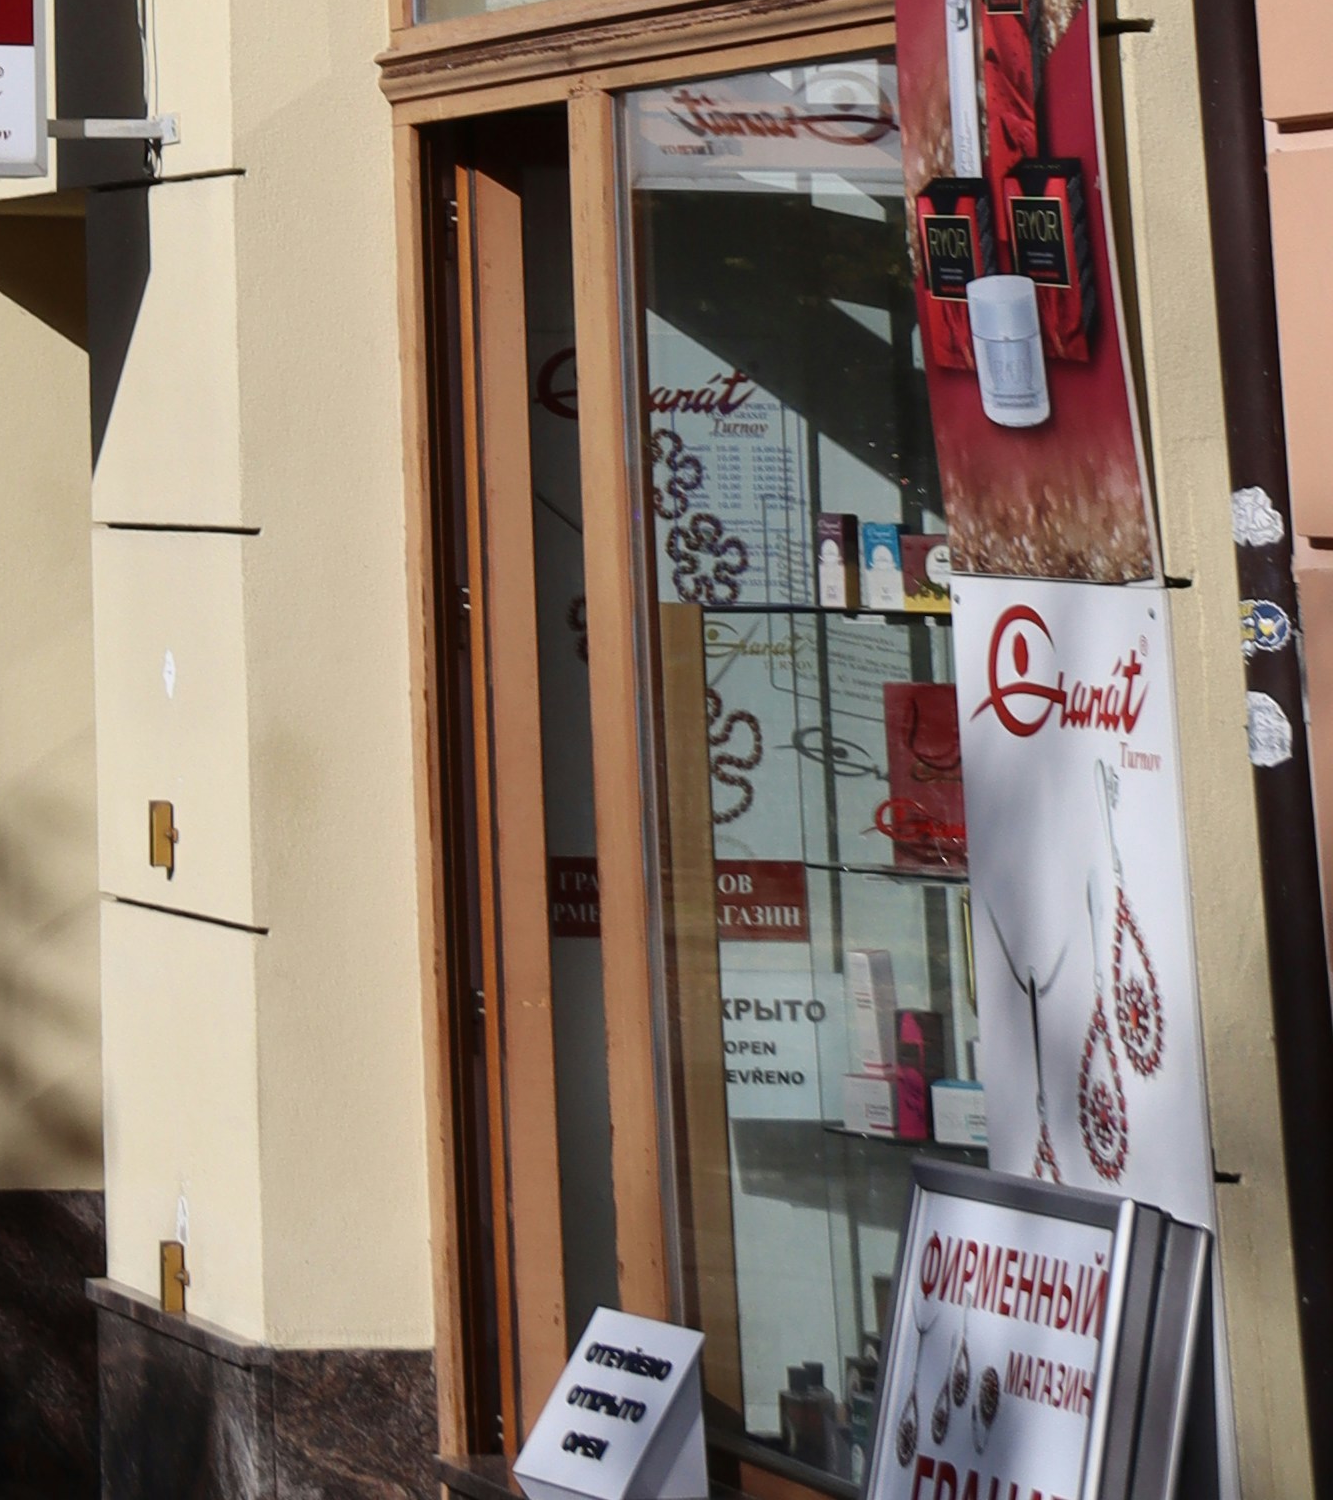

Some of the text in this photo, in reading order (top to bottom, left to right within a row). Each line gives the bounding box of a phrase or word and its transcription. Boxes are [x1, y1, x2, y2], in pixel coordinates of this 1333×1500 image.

[928, 227, 969, 258] RYOR
[1015, 209, 1060, 243] RYOR
[1119, 740, 1162, 772] Turnov
[724, 1040, 777, 1056] OPEN
[919, 1230, 1110, 1342] ФИРМЕННЫЙ
[1003, 1350, 1096, 1420] МАГАЗИН
